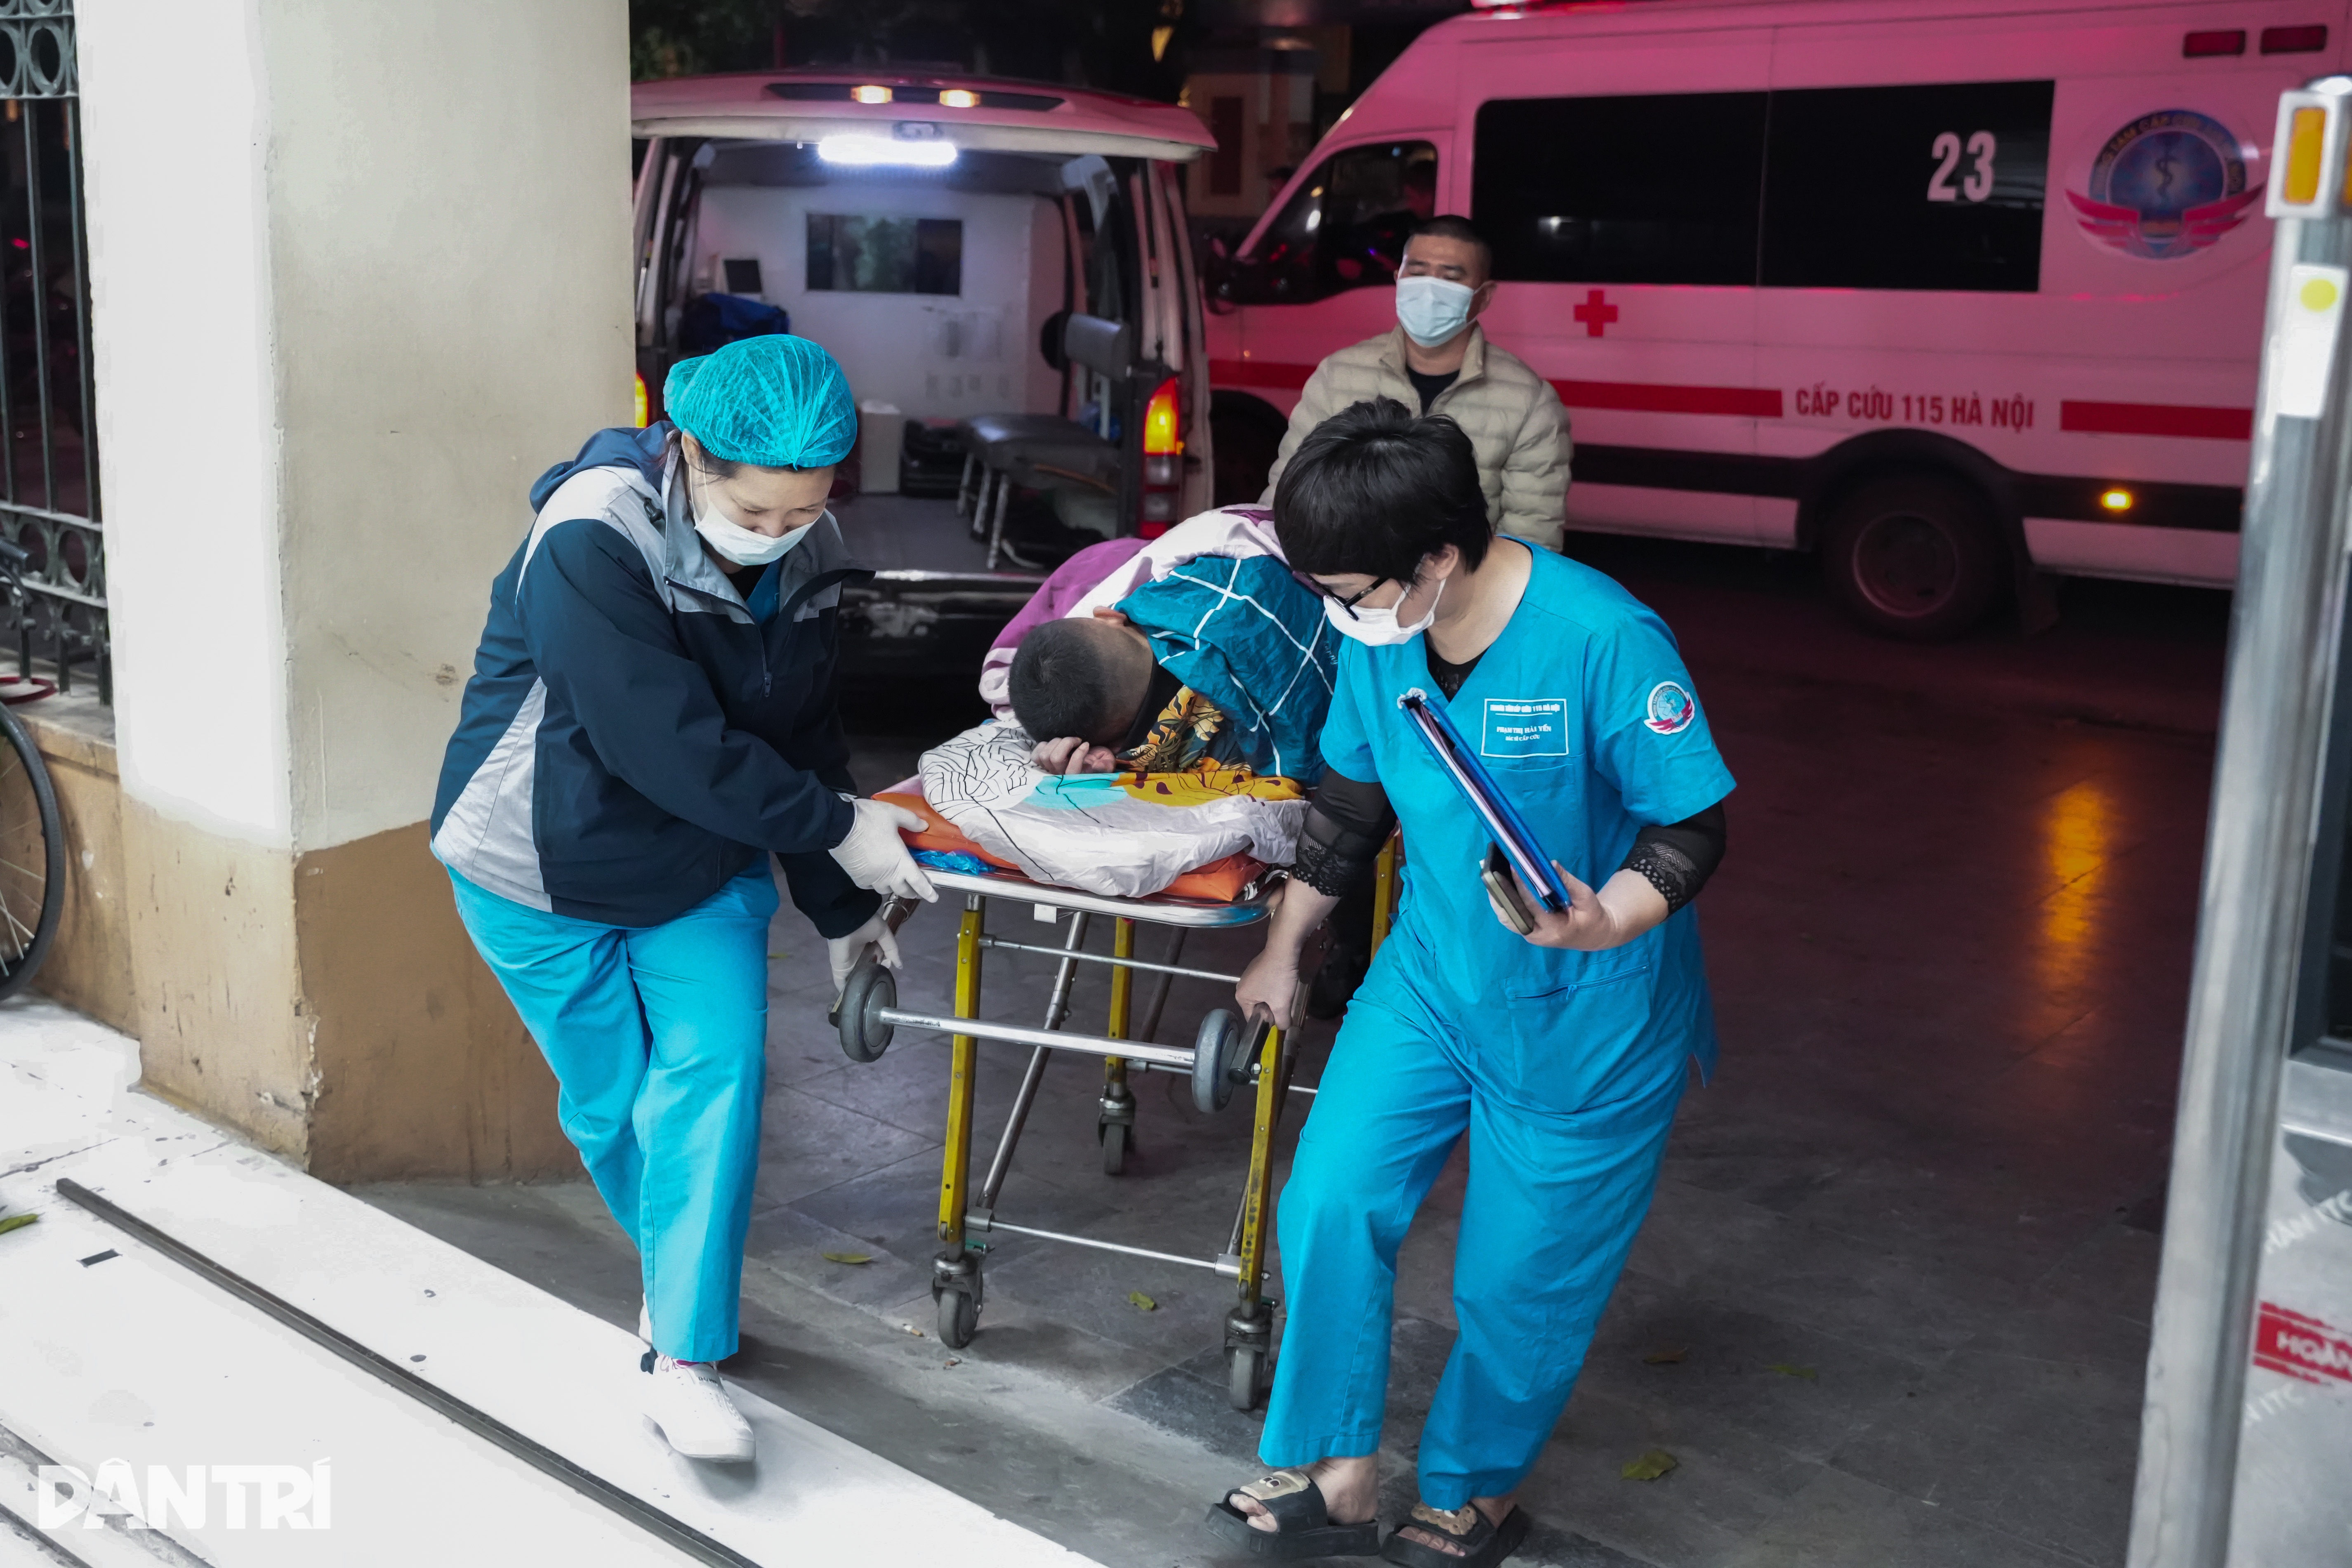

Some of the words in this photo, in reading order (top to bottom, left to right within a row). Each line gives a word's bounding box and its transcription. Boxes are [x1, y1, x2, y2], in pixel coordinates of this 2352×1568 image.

[1927, 130, 1996, 202] 23
[1796, 380, 1839, 416] CẤP
[1902, 394, 1943, 424] 115
[1951, 391, 1982, 427] HÀ
[1991, 392, 2034, 433] NỘI
